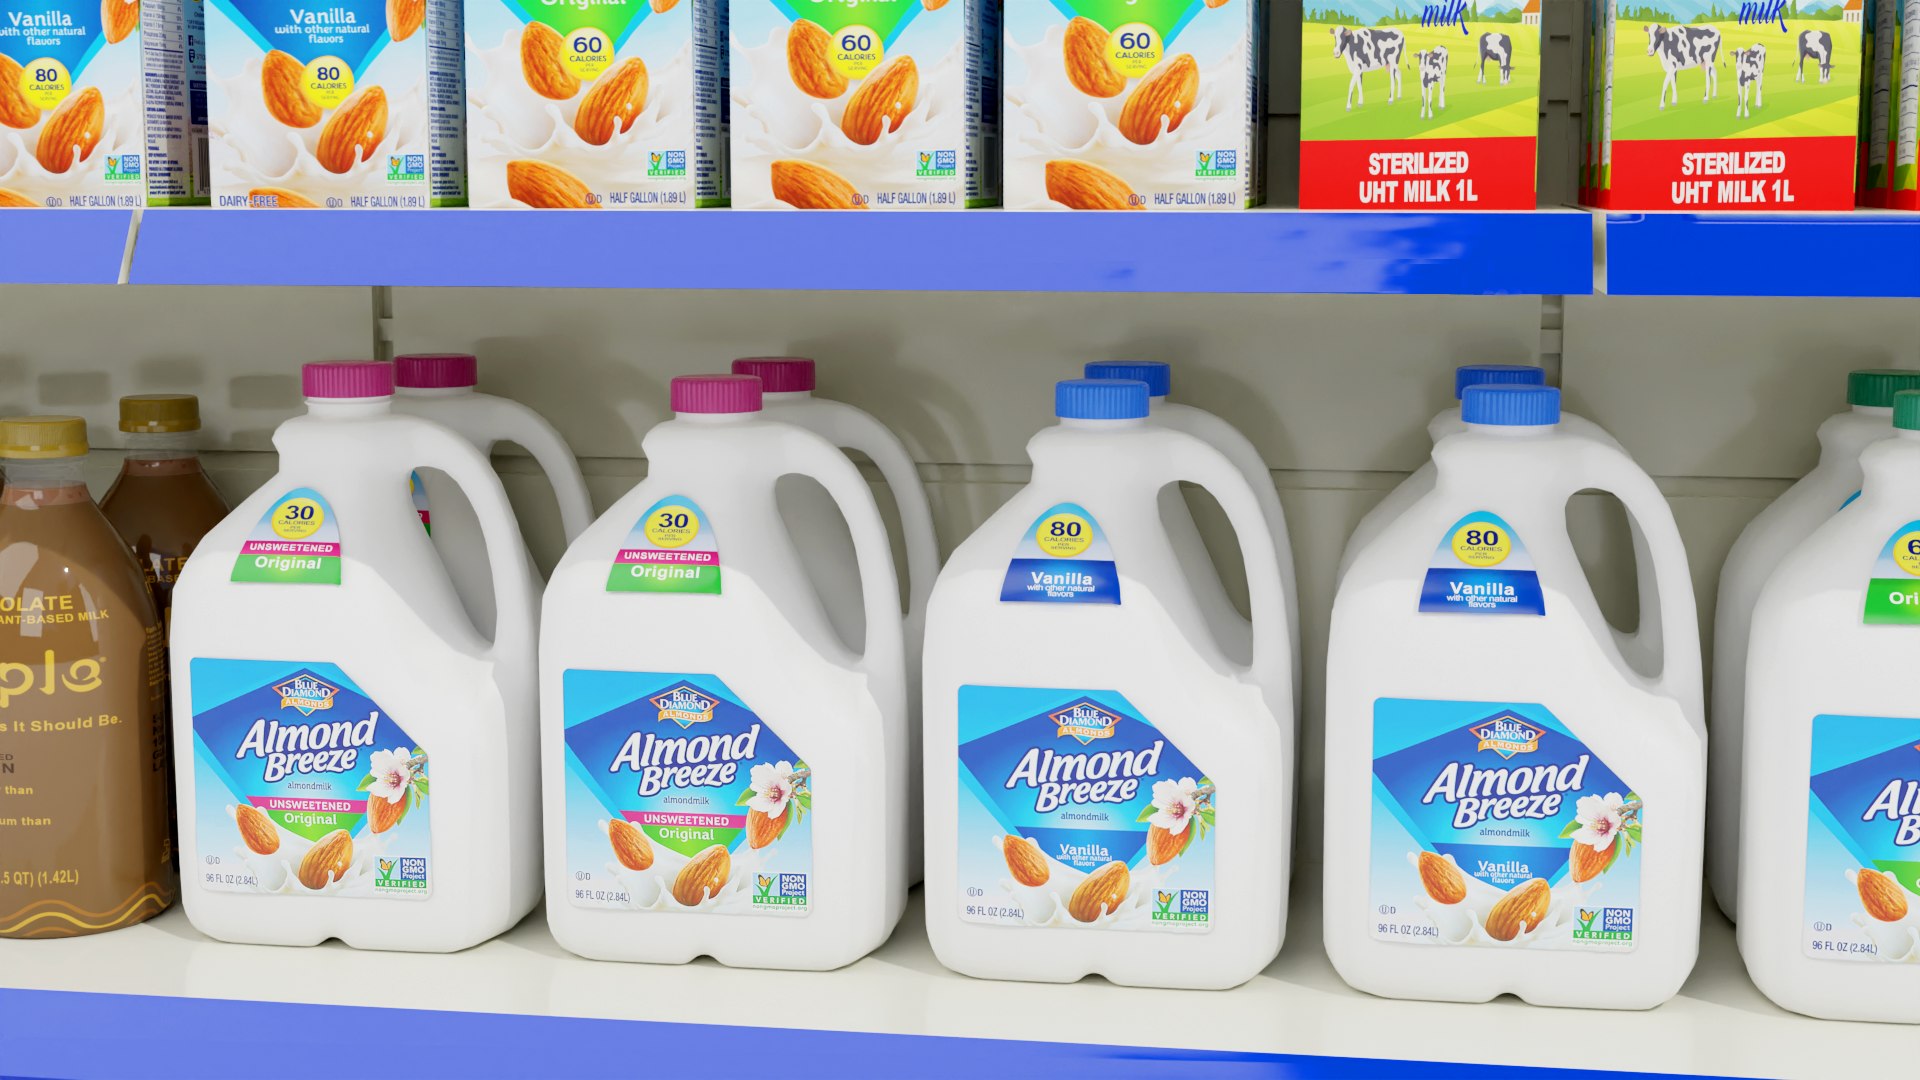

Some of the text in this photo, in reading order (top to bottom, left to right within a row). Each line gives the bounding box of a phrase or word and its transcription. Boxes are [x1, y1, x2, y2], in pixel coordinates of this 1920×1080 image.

[8, 10, 72, 26] Vanilla
[290, 9, 356, 24] Vanilla
[1421, 0, 1469, 35] milk
[1738, 0, 1788, 33] milk
[23, 26, 86, 36] other natural
[274, 24, 370, 34] with other natural
[26, 36, 61, 45] flavors
[309, 34, 344, 43] flavors
[573, 36, 602, 53] 60
[841, 35, 871, 52] 60
[1120, 33, 1150, 50] 60
[837, 53, 876, 61] CALORIES
[35, 69, 57, 82] 80
[317, 67, 340, 81] 80
[1368, 151, 1469, 175] STERILIZED
[1682, 151, 1786, 175] STERILIZED
[1359, 179, 1478, 203] UHT MILK 1L
[1671, 179, 1794, 204] UHT MILK 1L
[70, 196, 115, 207] HALF GALLON
[219, 195, 278, 207] DAIRY-FREE
[350, 196, 398, 207] HALF GALLON
[610, 192, 677, 204] HALF GALLON (1.89
[877, 192, 946, 205] HALF GALLON (1.89
[1154, 193, 1226, 206] HALF GALLON (1.89
[285, 505, 315, 521] 30
[658, 513, 689, 528] 30
[1050, 521, 1082, 537] 80
[1466, 530, 1499, 546] 80
[249, 543, 334, 553] UNSWEETENED
[255, 555, 322, 571] Original
[624, 552, 712, 562] UNSWEETENED
[631, 565, 701, 581] Original
[1031, 571, 1093, 585] Vanilla
[1450, 581, 1515, 595] Vanilla
[1446, 594, 1518, 603] with other natural
[1889, 591, 1919, 605] Ori
[78, 610, 109, 621] MILK
[295, 680, 319, 690] BLUE
[282, 687, 331, 698] DIAMOND
[673, 691, 697, 702] BLUE
[285, 699, 330, 708] ALMONDS
[660, 699, 711, 711] DIAMOND
[663, 711, 708, 721] ALMONDS
[1073, 707, 1099, 718] BLUE
[14, 714, 123, 732] It Should Be.
[1060, 715, 1113, 727] DIAMOND
[1495, 721, 1522, 732] BLUE
[236, 711, 379, 759] Almond
[1062, 727, 1111, 737] ALMONDS
[1480, 728, 1536, 740] DIAMOND
[609, 723, 761, 772] Almond
[1483, 740, 1534, 750] ALMONDS
[263, 749, 357, 782] Breeze
[1005, 739, 1164, 789] Almond
[638, 761, 737, 797] Breeze
[1422, 755, 1590, 804] Almond
[5, 786, 33, 795] than
[288, 781, 332, 791] almondmilk
[663, 795, 710, 805] almondmilk
[1035, 777, 1139, 814] Breeze
[269, 800, 351, 811] UNSWEETENED
[1453, 793, 1562, 829] Breeze
[21, 817, 51, 826] than
[284, 812, 337, 827] Original
[643, 814, 730, 826] UNSWEETENED
[1060, 811, 1109, 821] almondmilk
[659, 828, 715, 842] Original
[1479, 827, 1530, 837] almondmilk
[1060, 844, 1109, 856] Vanilla
[1072, 854, 1088, 862] other
[1074, 859, 1095, 867] flavors
[1478, 860, 1529, 873] Vanilla
[13, 869, 79, 887] QT) (1.42L)
[206, 873, 258, 887] 96 FL OZ (2.84L)
[782, 874, 804, 882] NON
[1490, 871, 1508, 879] other
[1492, 876, 1515, 884] flavors
[781, 882, 805, 890] GMO
[575, 889, 630, 902] 96 FL OZ (2.84L)
[755, 896, 806, 905] VERIFIED
[1183, 891, 1206, 899] NON
[1182, 899, 1207, 907] GMO
[967, 905, 1025, 920] 96 FL OZ (2.84L)
[1154, 912, 1207, 921] VERIFIED
[1606, 908, 1631, 917] NON
[1605, 916, 1631, 925] GMO
[1378, 923, 1439, 938] 96 FL OZ (2.84L)
[1575, 930, 1631, 940] VERIFIED
[1812, 940, 1877, 955] 96 FL OZ (2.84L)
